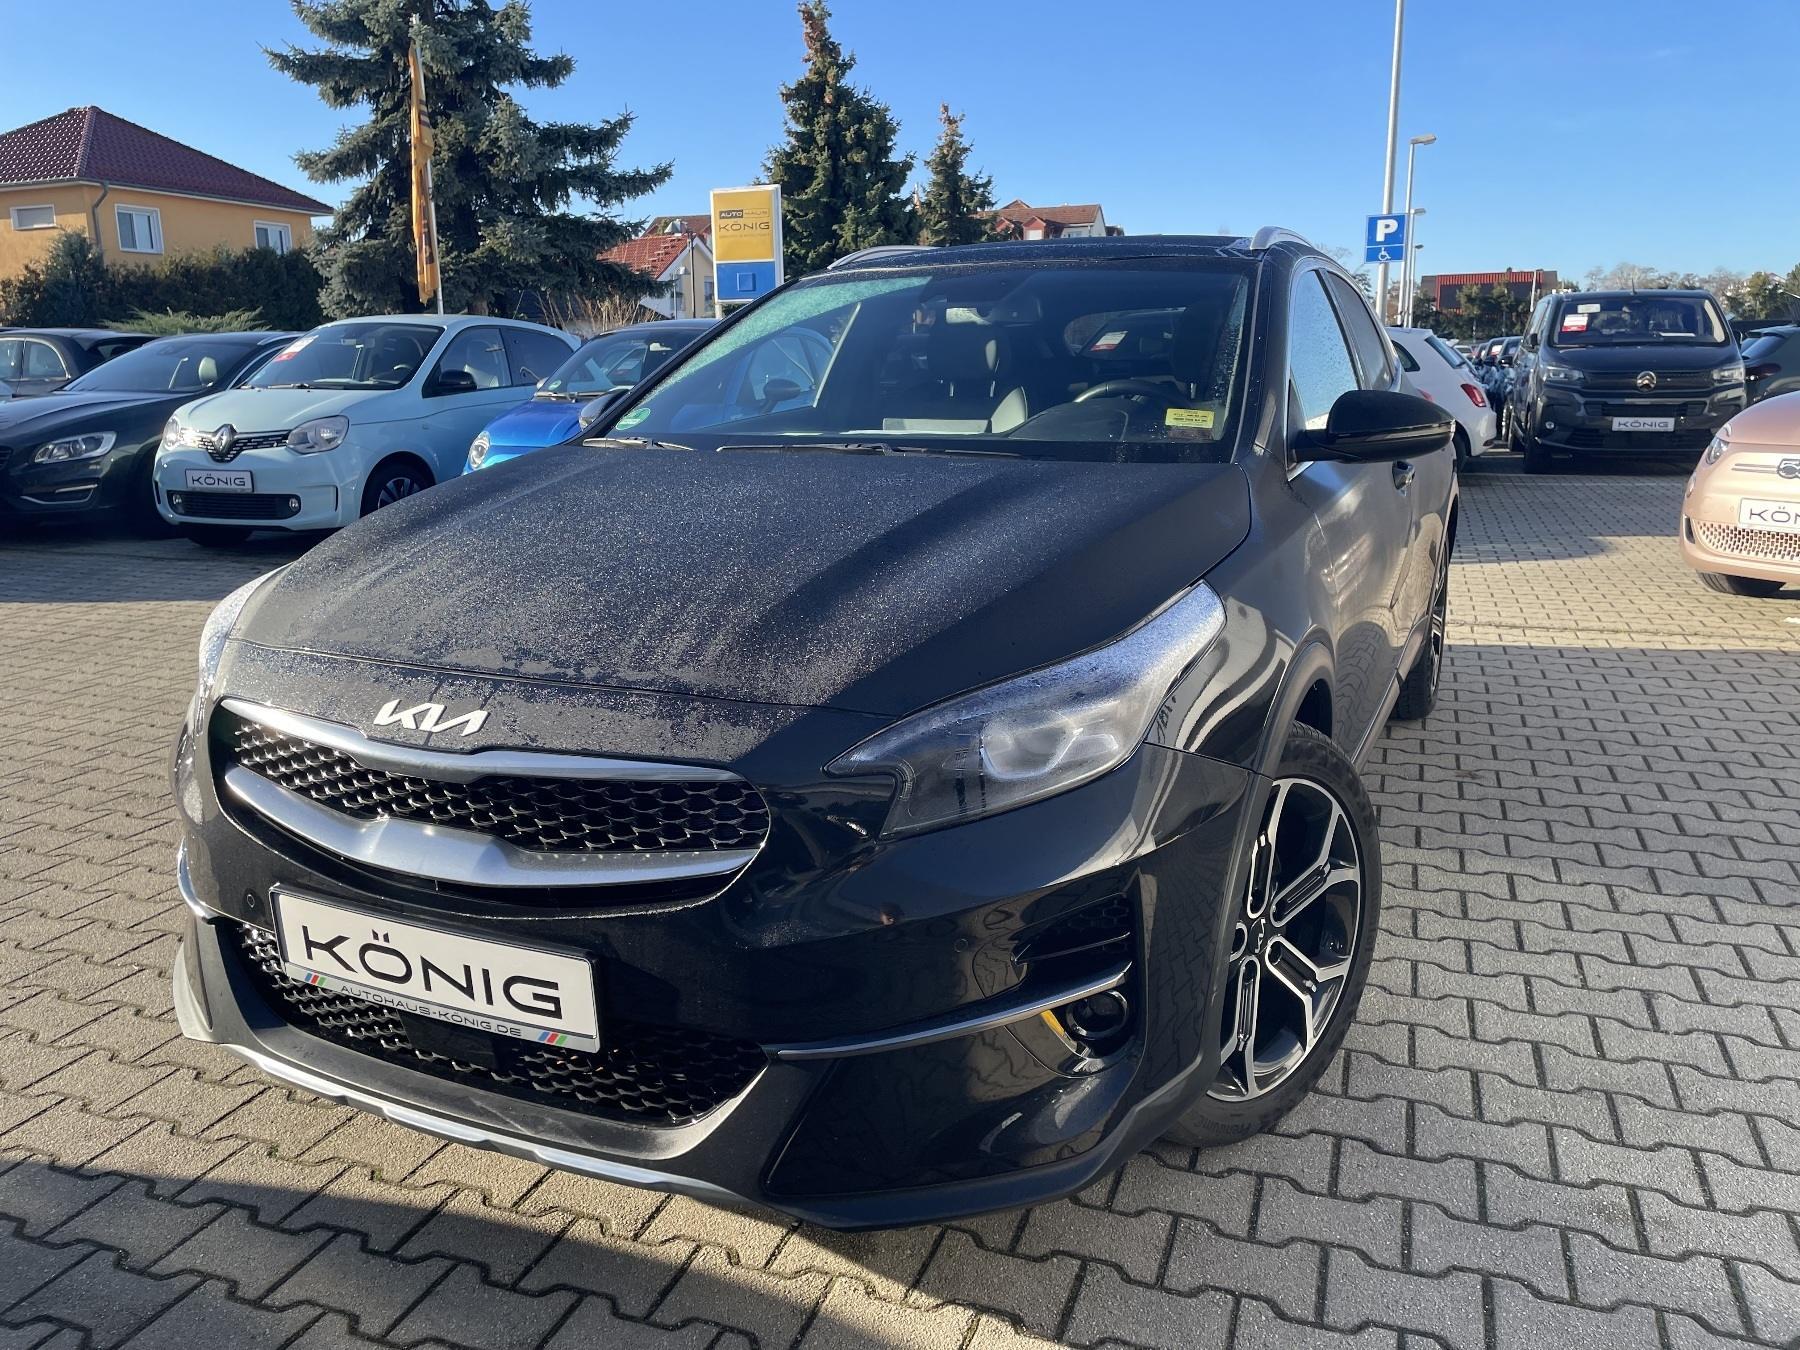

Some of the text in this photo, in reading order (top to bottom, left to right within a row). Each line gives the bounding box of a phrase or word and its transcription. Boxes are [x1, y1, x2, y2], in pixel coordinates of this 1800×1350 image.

[718, 220, 770, 232] KÖNIG
[1376, 219, 1398, 242] P
[1617, 420, 1669, 428] KÖNIG
[191, 473, 246, 486] KÖNIG
[373, 699, 490, 737] KIA
[302, 925, 563, 1019] KÖNIG
[340, 984, 522, 1037] AUTOHAUS-KÖNIG.DE
